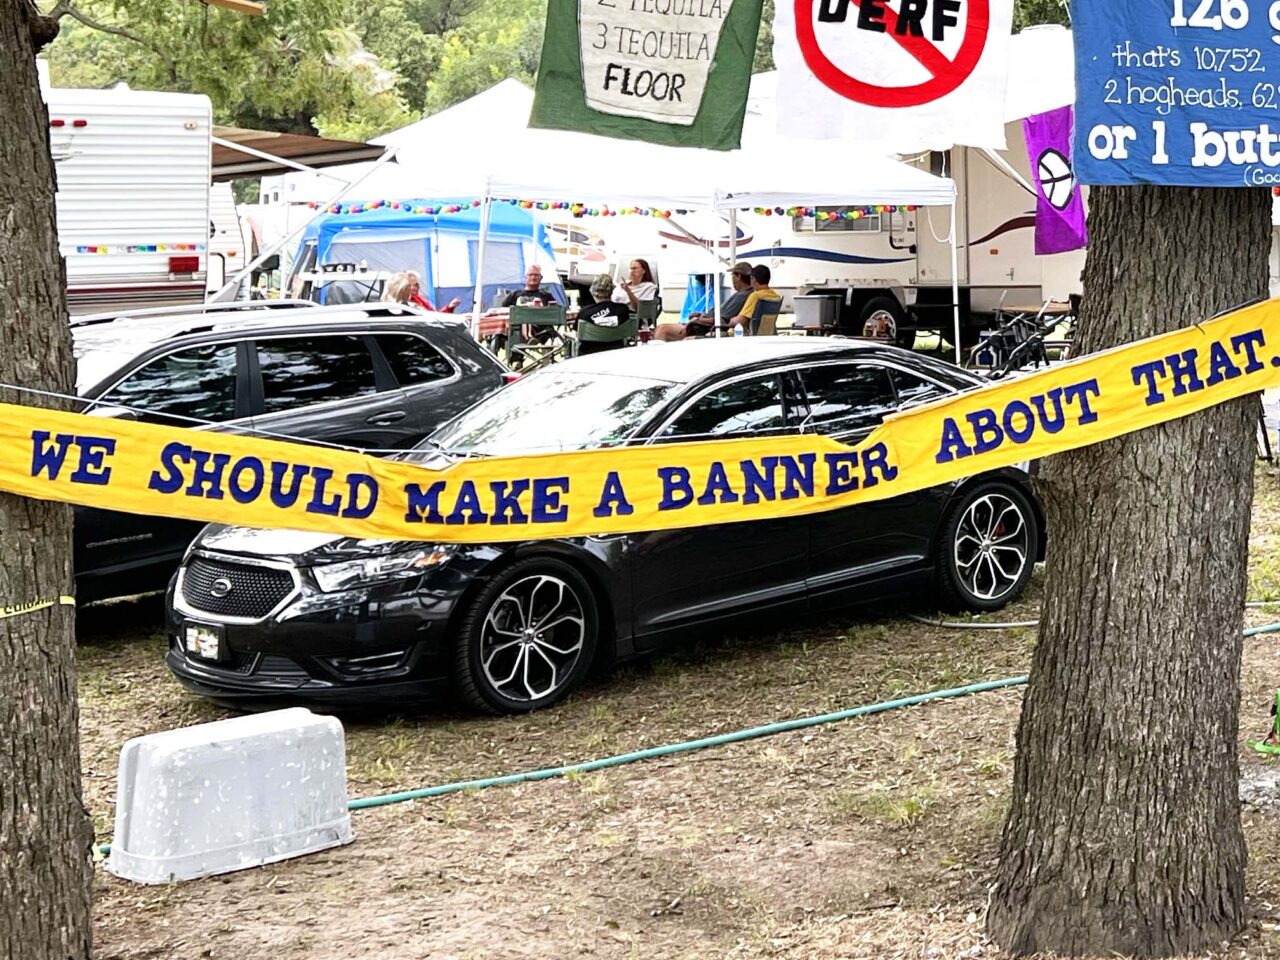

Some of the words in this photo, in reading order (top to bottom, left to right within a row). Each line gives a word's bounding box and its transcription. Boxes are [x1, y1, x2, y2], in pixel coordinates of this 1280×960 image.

[593, 22, 608, 50] 3
[1112, 40, 1181, 68] that's
[603, 62, 686, 102] FLOOR
[1104, 80, 1122, 104] 2
[1127, 77, 1243, 116] hogheads,
[1088, 124, 1137, 160] or
[31, 430, 117, 486] WE
[148, 441, 380, 519] SHOULD
[404, 476, 569, 526] MAKE
[593, 471, 634, 517] A
[658, 441, 899, 511] BANNER
[935, 378, 1100, 464] ABOUT
